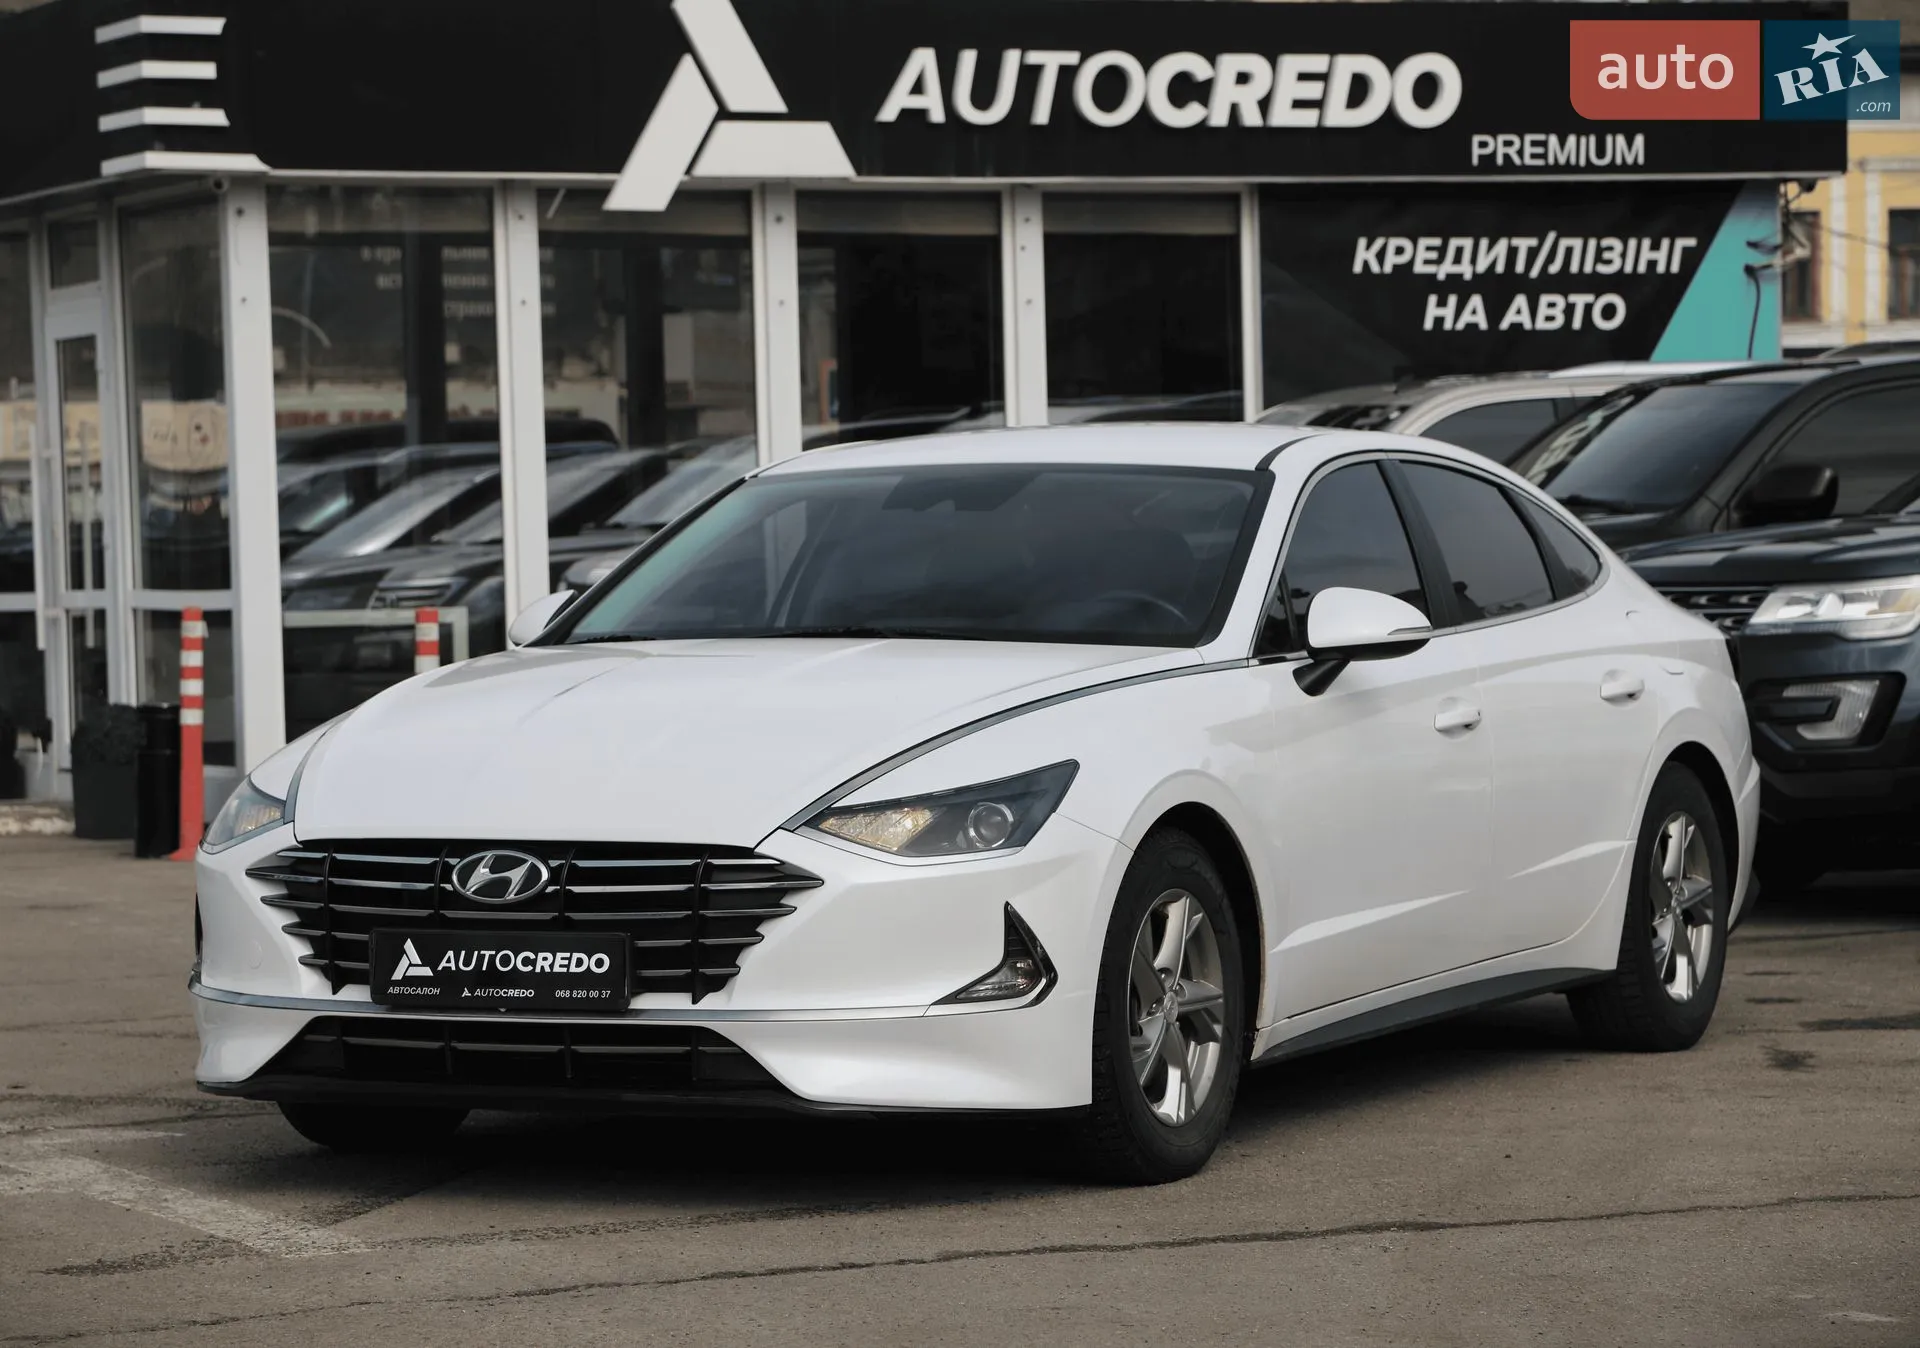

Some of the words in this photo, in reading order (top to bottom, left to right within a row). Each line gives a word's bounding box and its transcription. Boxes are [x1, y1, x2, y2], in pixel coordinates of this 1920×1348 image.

[876, 47, 1463, 128] AUTOCREDO
[1471, 133, 1645, 167] PREMIUM
[1352, 231, 1698, 281] КРЕДИТ/ЛІЗІНГ
[1423, 293, 1489, 331] НА
[1499, 293, 1627, 331] АВТО
[437, 949, 611, 974] AUTOCREDO
[387, 986, 441, 995] АВТОСАЛОН
[474, 988, 535, 998] AUTOCREDO
[555, 989, 571, 998] 068
[572, 989, 588, 998] 820
[588, 989, 600, 998] 00
[600, 989, 611, 999] 37
